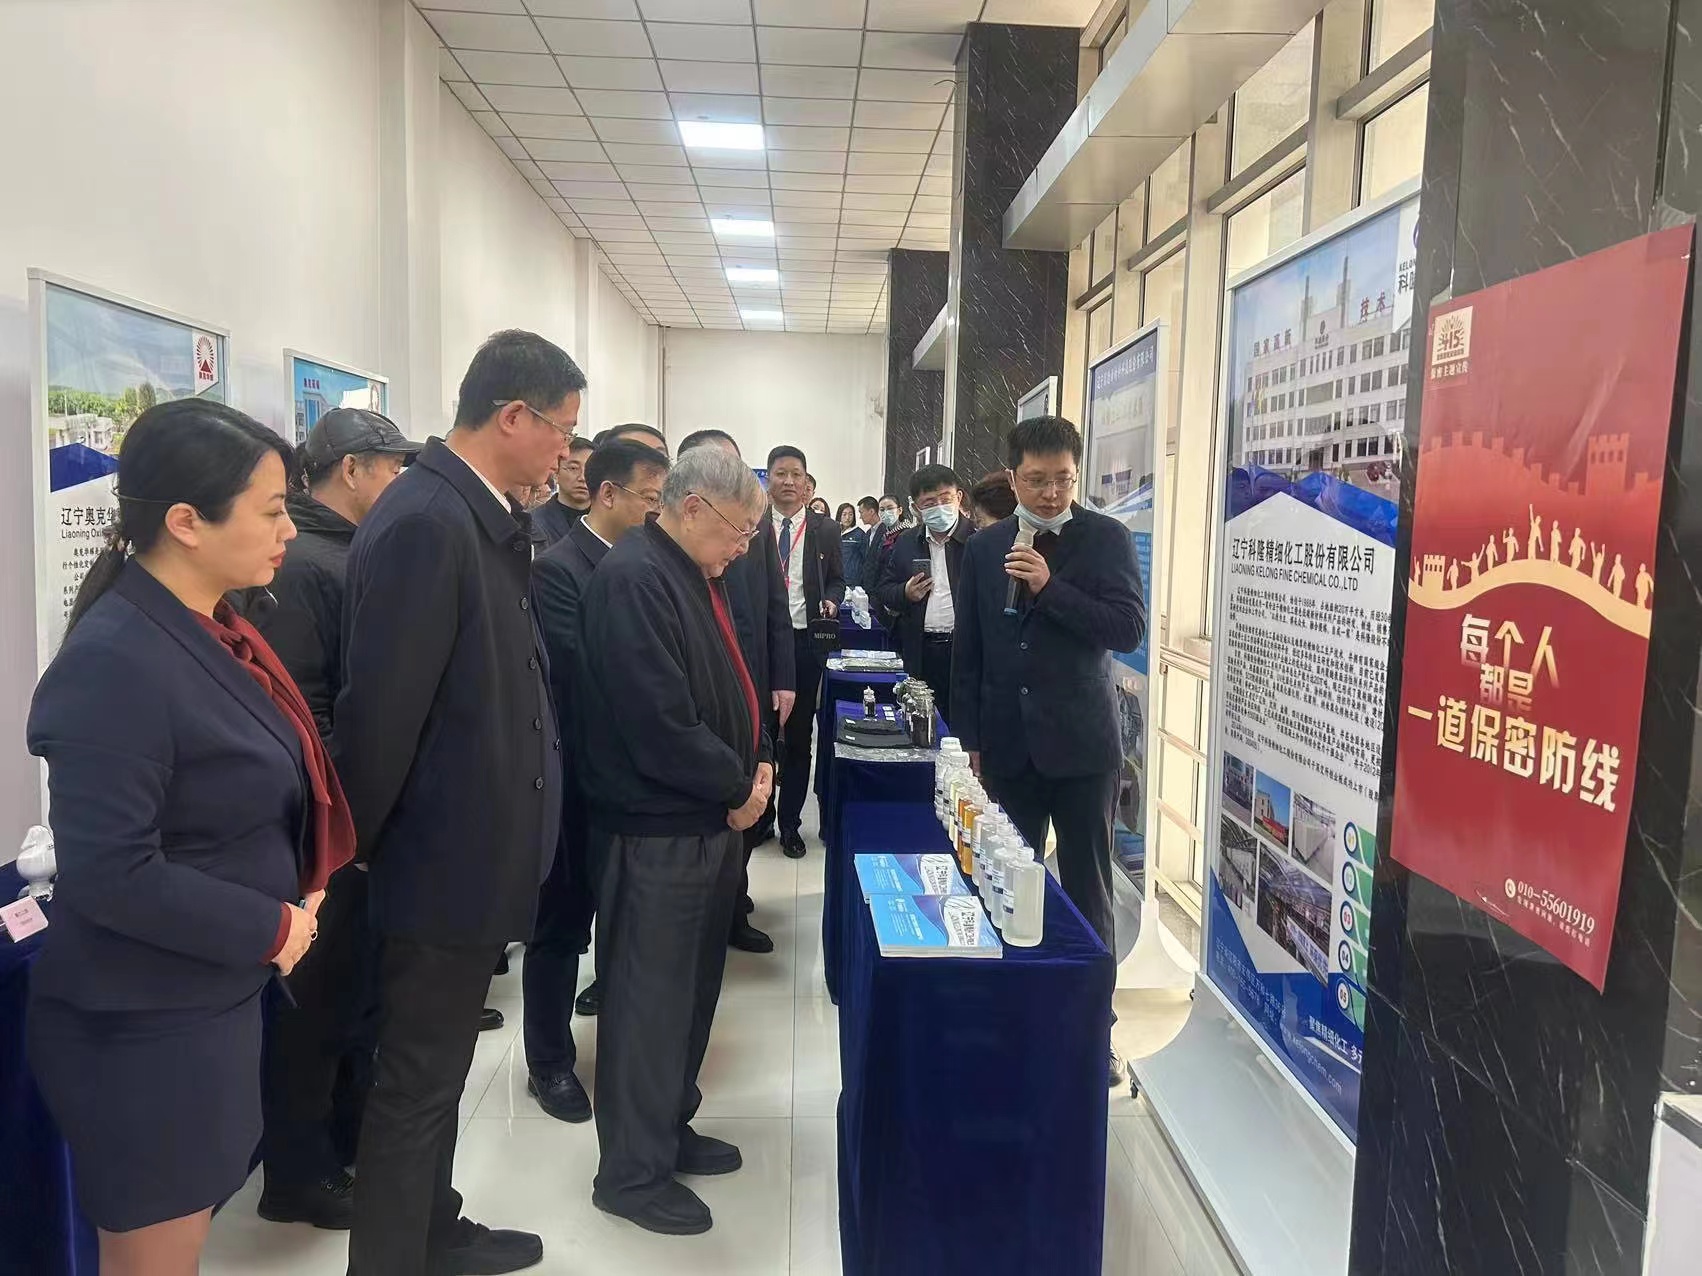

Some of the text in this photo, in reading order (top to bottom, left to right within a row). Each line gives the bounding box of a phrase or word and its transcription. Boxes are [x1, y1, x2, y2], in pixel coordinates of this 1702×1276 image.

[61, 529, 90, 540] Liaoning
[1231, 538, 1375, 575] 辽宁科隆精细化工股份有限公司
[1231, 563, 1255, 576] LIAONING
[1256, 566, 1278, 580] KELONG
[1279, 569, 1293, 582] FINE
[1293, 571, 1327, 587] CHEMICAL
[814, 632, 836, 640] MIPRO
[1460, 613, 1560, 689] 每个人
[1480, 662, 1534, 713] 都是
[1407, 694, 1621, 812] 一道保密防线
